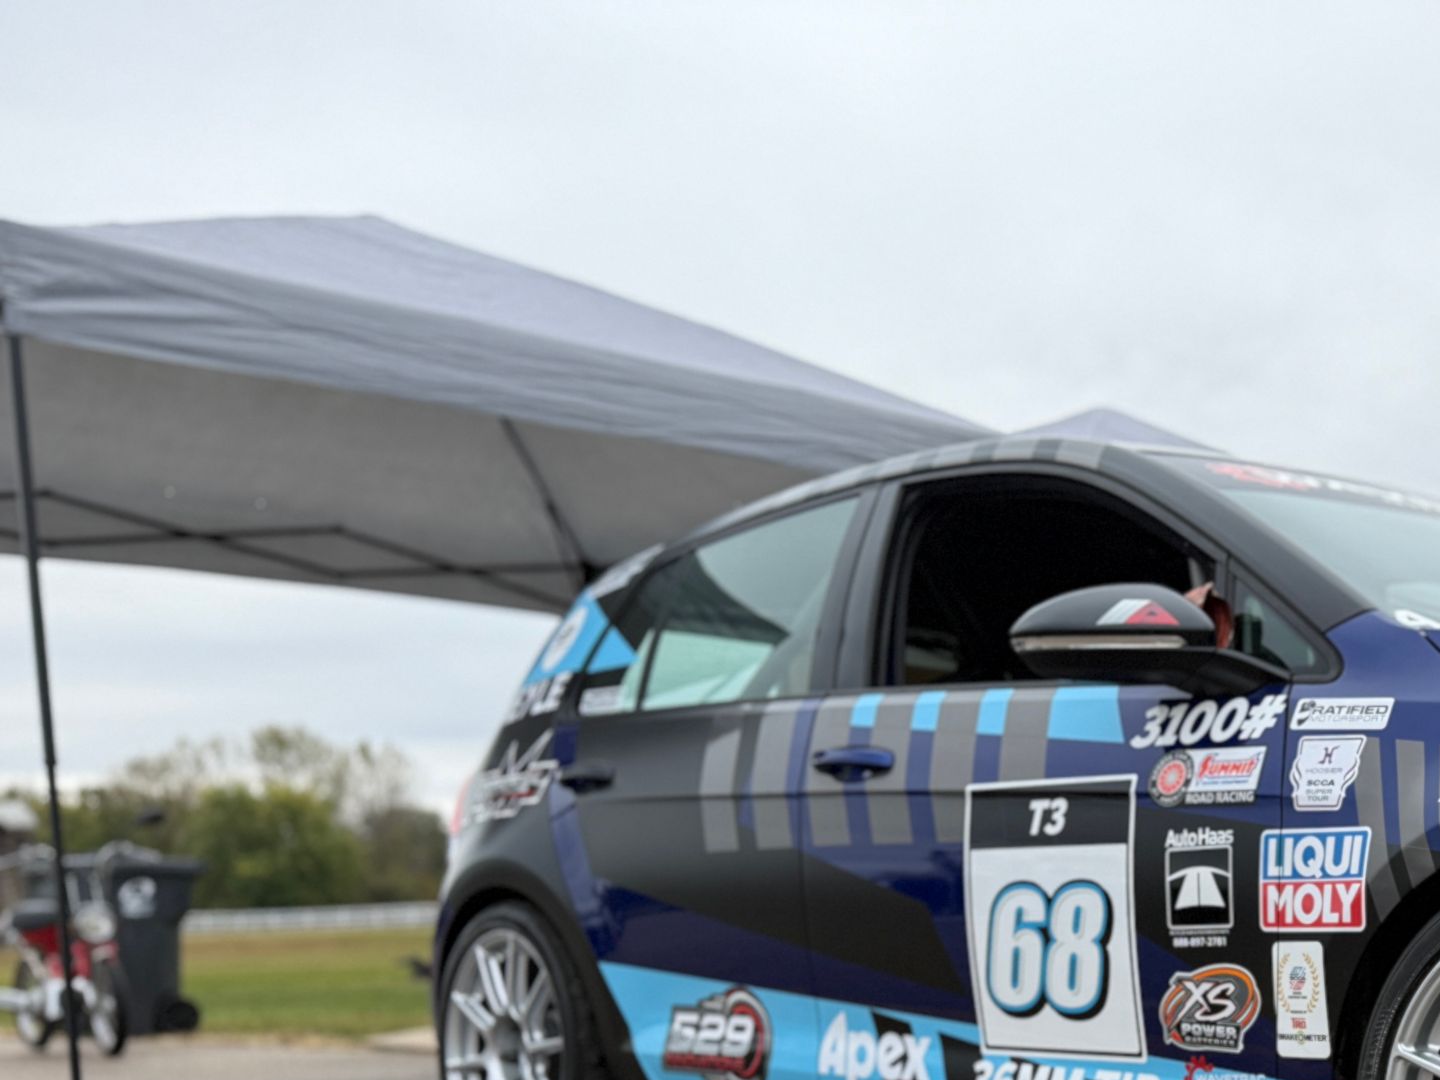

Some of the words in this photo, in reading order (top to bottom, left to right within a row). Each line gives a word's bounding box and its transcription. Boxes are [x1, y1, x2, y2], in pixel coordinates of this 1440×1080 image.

[1130, 694, 1288, 749] 3100#
[1028, 797, 1069, 836] T3
[1185, 792, 1214, 804] ROAD
[1215, 791, 1255, 803] RACING
[1266, 834, 1364, 879] LIQUI
[1266, 882, 1361, 926] MOLY
[986, 879, 1113, 1021] 68
[1170, 981, 1236, 1027] XS
[665, 1010, 755, 1058] 529
[1181, 1022, 1237, 1039] POWER
